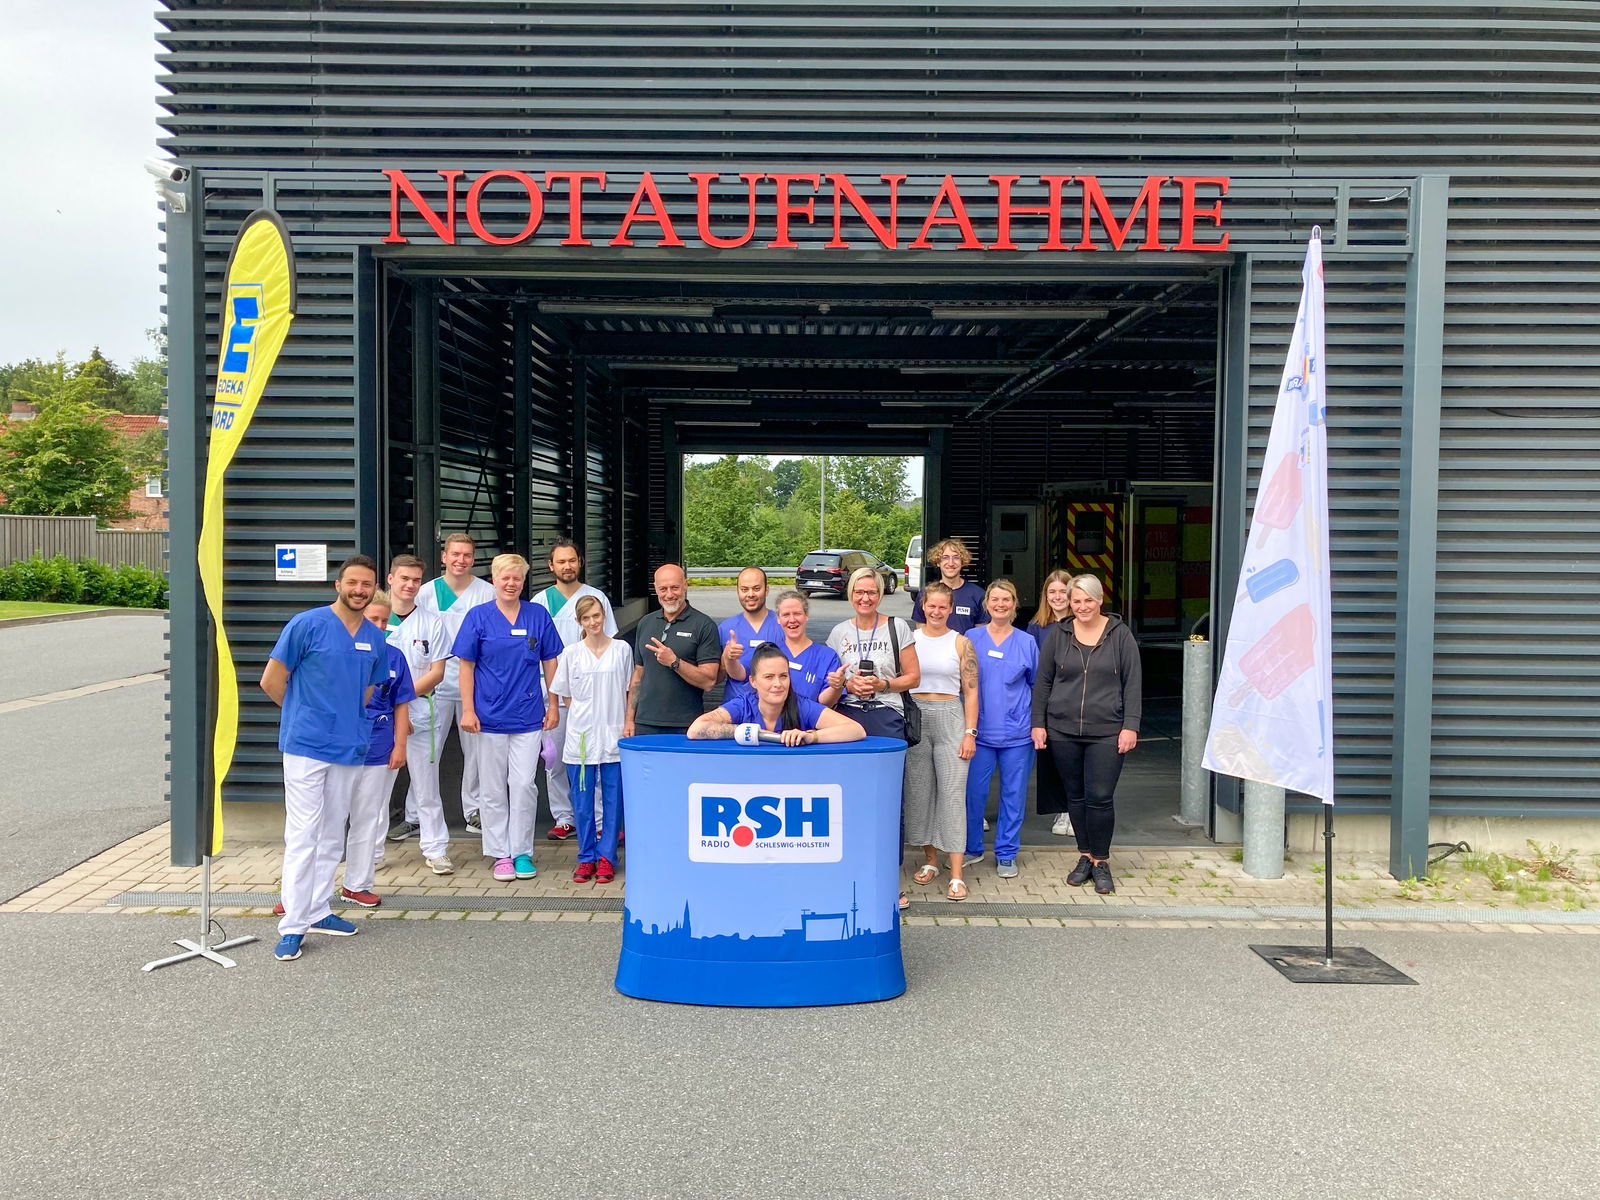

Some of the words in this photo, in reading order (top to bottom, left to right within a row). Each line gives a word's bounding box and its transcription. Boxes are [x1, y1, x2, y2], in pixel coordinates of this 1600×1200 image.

[381, 169, 1230, 252] NOTAUFNAHME
[217, 379, 244, 395] EDEKA
[701, 840, 730, 848] RADIO
[755, 841, 830, 849] SCHLESWIG-HOLSTEIN
